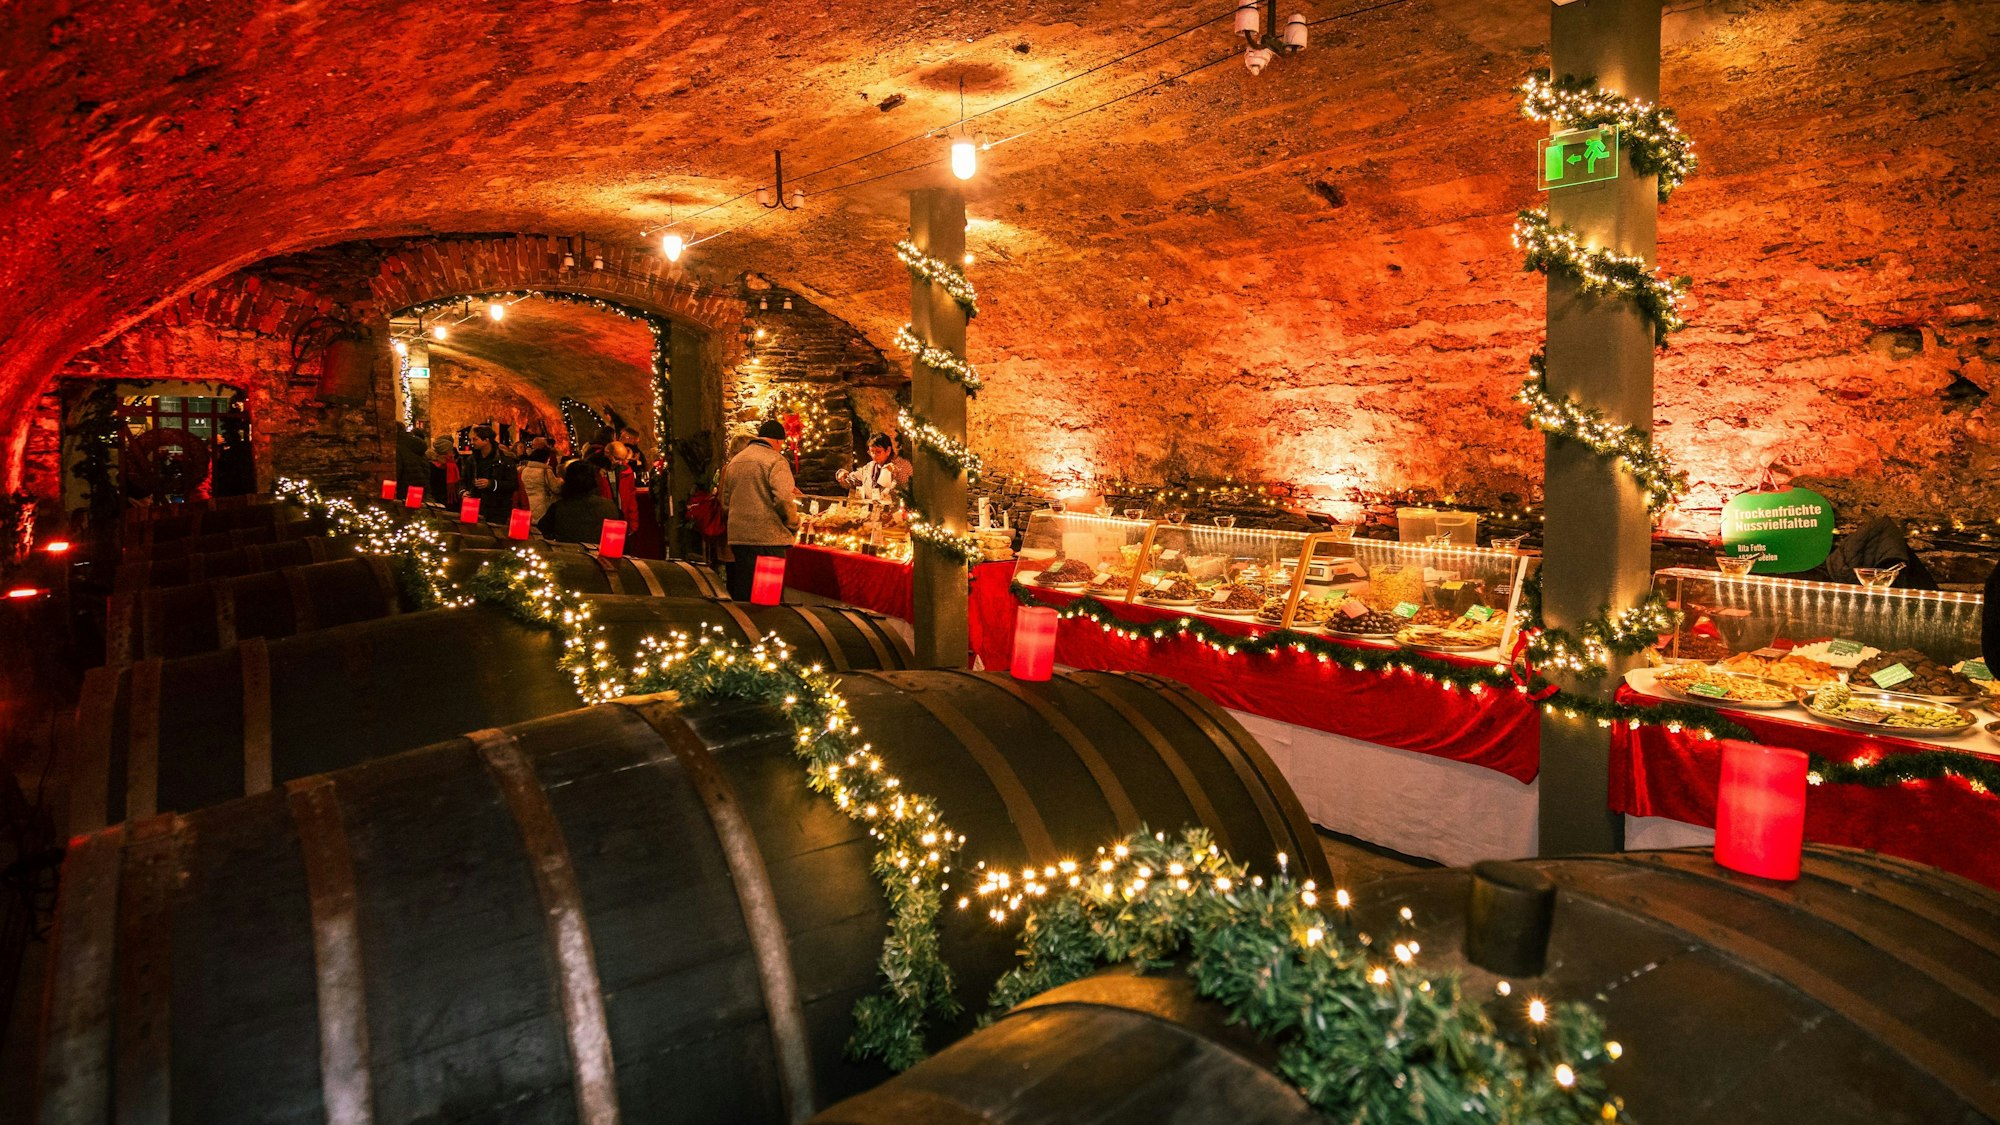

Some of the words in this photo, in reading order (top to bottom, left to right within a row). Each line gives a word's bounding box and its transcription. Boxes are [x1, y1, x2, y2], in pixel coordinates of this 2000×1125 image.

[1735, 504, 1821, 519] Trockenfrüchte
[1735, 518, 1817, 532] Nussvielfalten
[1738, 544, 1749, 552] Rita
